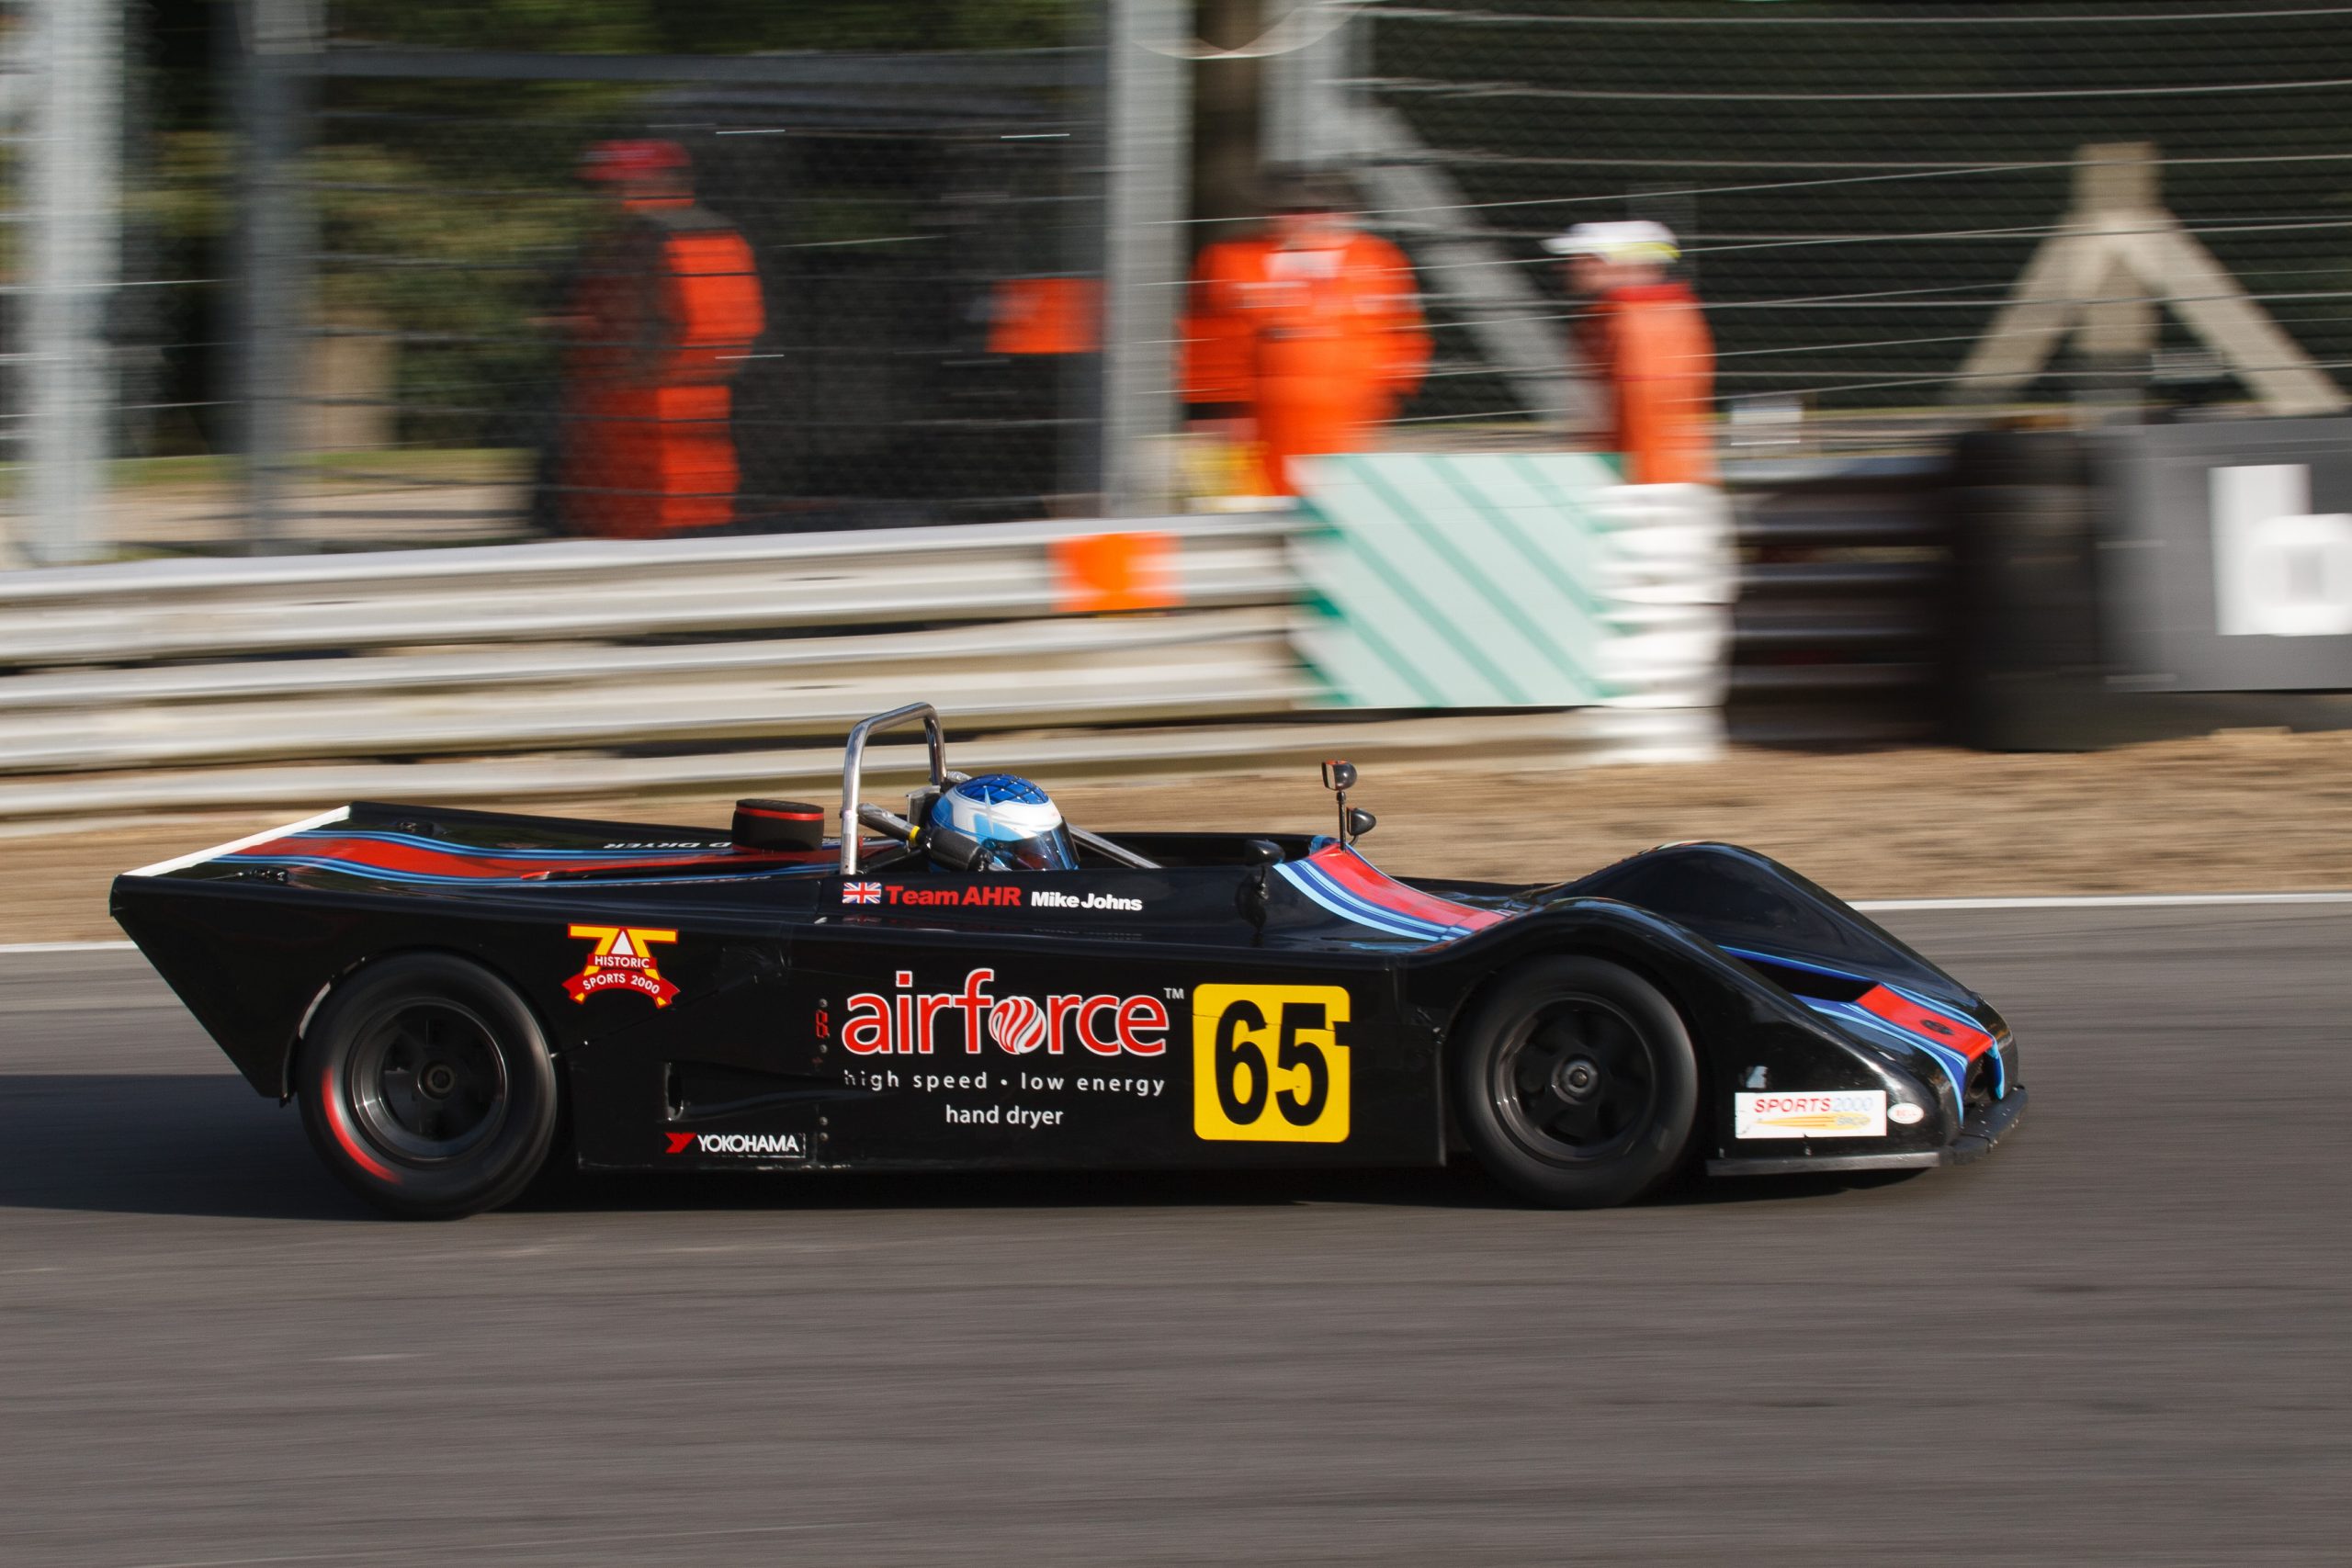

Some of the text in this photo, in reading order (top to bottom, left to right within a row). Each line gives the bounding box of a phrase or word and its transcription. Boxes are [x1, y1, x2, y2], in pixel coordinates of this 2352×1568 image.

[603, 841, 701, 850] DRYER
[884, 885, 1022, 907] Team AHR
[1030, 891, 1144, 911] Mike Johns
[594, 955, 650, 968] HISTORIC
[582, 973, 661, 995] SPORTS 2000
[841, 967, 1170, 1057] airforce
[1215, 999, 1330, 1127] 65
[843, 1069, 1165, 1097] high speed low energy
[945, 1104, 1064, 1130] hand dryer
[696, 1134, 800, 1153] YOKOHAMA
